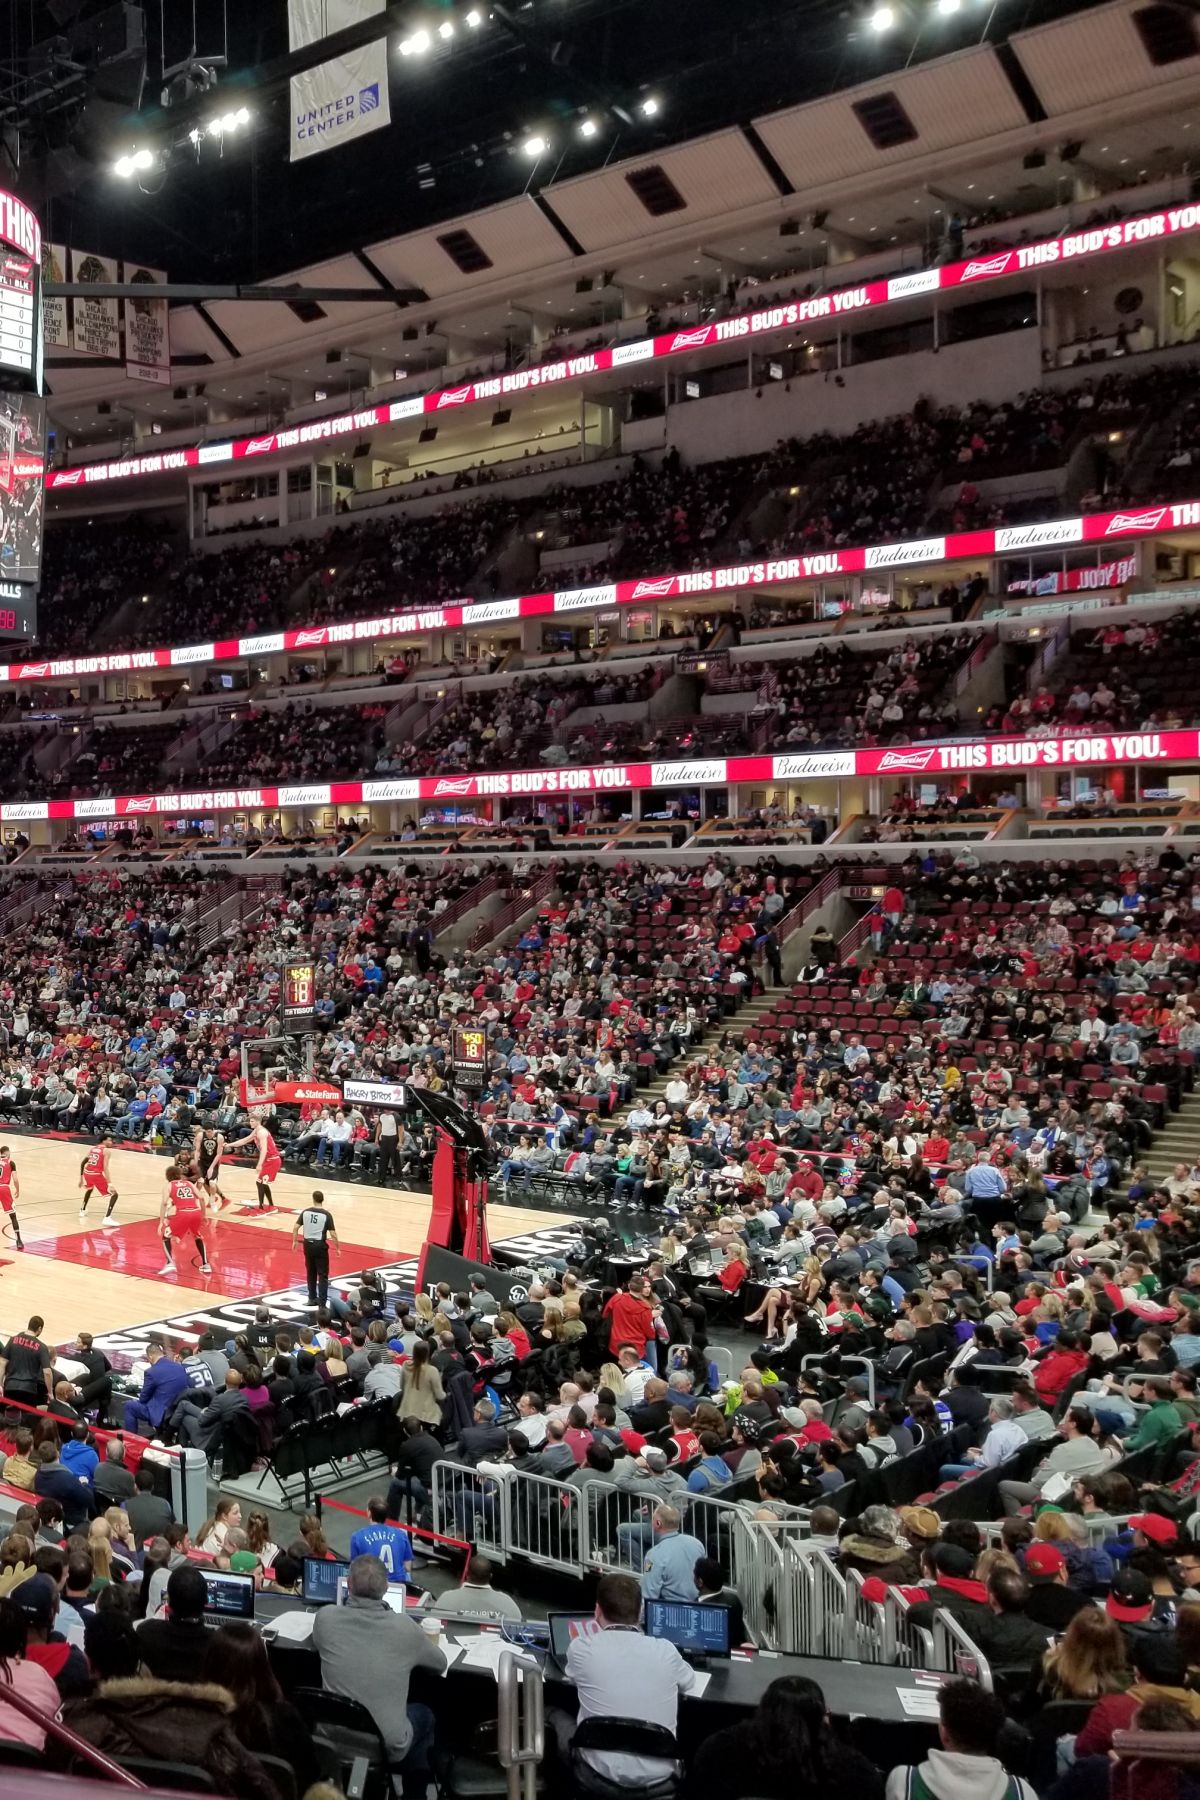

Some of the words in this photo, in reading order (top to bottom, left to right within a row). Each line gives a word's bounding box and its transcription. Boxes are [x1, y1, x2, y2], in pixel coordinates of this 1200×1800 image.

[297, 95, 355, 125] UNITED
[297, 111, 355, 139] CENTER
[1017, 241, 1059, 267] THIS
[1063, 226, 1122, 257] BUD'S
[1125, 215, 1165, 242] FOR
[716, 317, 749, 339] THIS
[752, 305, 797, 331] BUD'S
[800, 297, 830, 320] FOR
[833, 288, 870, 311] YOU.
[474, 379, 501, 398] THIS
[503, 369, 540, 392] BUD'S
[541, 363, 566, 382] FOR
[568, 355, 598, 375] YOU.
[999, 521, 1078, 548] Budweiser
[869, 541, 945, 566] Budweiser
[677, 572, 713, 592] THIS
[716, 564, 764, 587] BUD'S
[767, 560, 799, 580] FOR
[803, 554, 842, 575] YOU.
[938, 745, 987, 768] THIS
[992, 741, 1058, 765] BUD'S
[1063, 739, 1107, 761] FOR
[1112, 735, 1166, 758] YOU.
[655, 761, 722, 781] Budweiser
[776, 756, 850, 776] Budweiser
[475, 775, 509, 794] THIS
[512, 772, 558, 792] BUD'S
[560, 770, 590, 789] FOR
[593, 768, 630, 787] YOU.
[291, 967, 310, 981] 4:50
[293, 982, 308, 1003] 18
[293, 1006, 314, 1015] TISSOT
[462, 1033, 482, 1045] 4:50
[466, 1044, 478, 1058] 18
[463, 1061, 483, 1069] TISSOT
[345, 1088, 369, 1101] ANGRY
[370, 1091, 392, 1102] BIRDS
[176, 1187, 193, 1199] 42
[310, 1213, 319, 1224] 15
[13, 1336, 40, 1351] BULLS
[189, 1368, 214, 1389] 34
